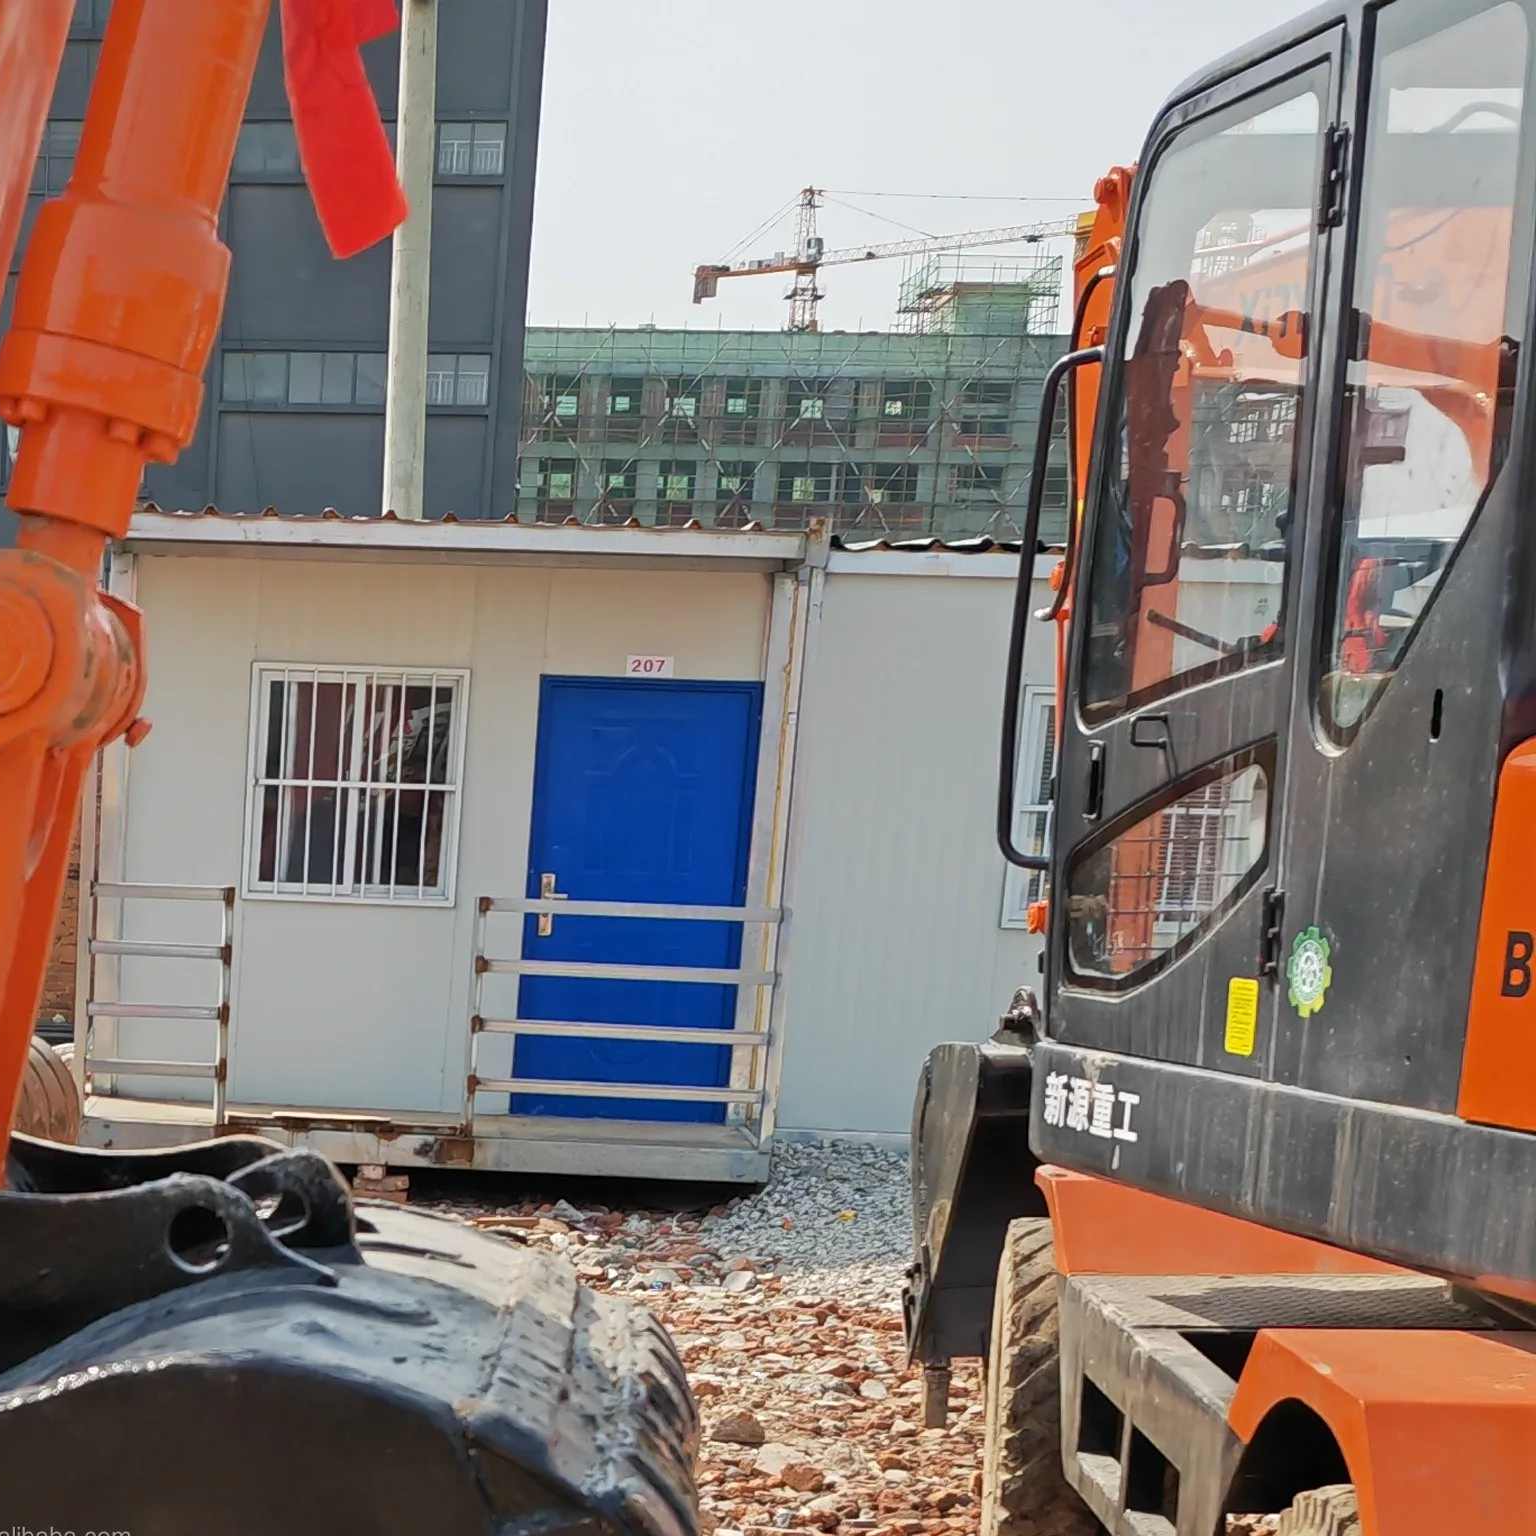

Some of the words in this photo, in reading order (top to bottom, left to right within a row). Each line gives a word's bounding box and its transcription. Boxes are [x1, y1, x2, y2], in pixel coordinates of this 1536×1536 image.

[631, 659, 666, 673] 207
[1044, 1071, 1140, 1142] 新源重工
